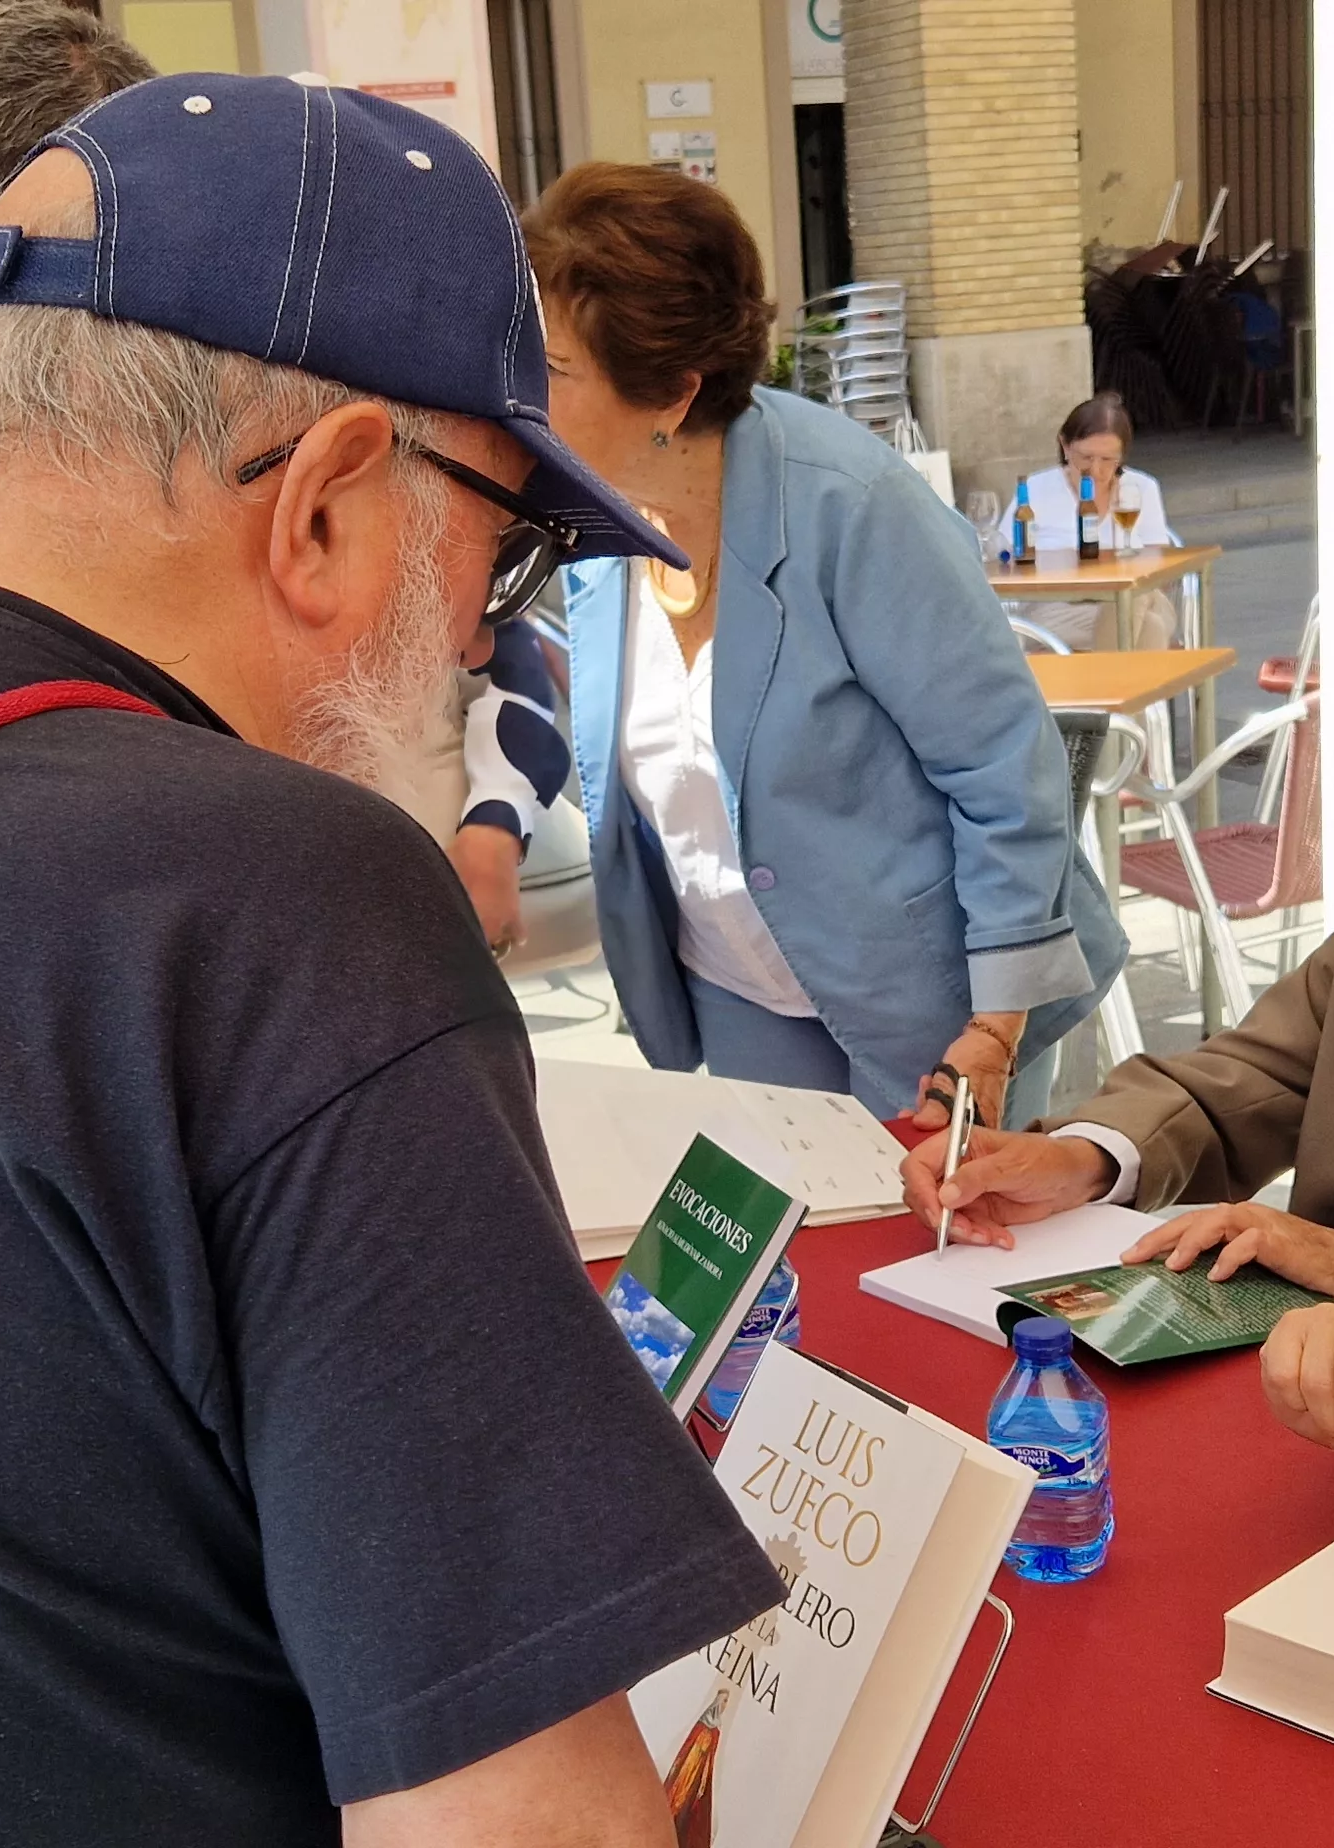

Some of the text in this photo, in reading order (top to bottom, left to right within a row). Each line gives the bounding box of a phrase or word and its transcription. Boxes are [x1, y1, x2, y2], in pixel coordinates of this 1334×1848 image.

[668, 1178, 754, 1254] EVOCACIONES
[792, 1399, 886, 1488] LUIS
[1012, 1446, 1051, 1458] MONTE
[1017, 1455, 1051, 1466] PINOS
[740, 1443, 882, 1568] ZUECO
[757, 1617, 777, 1647] LA
